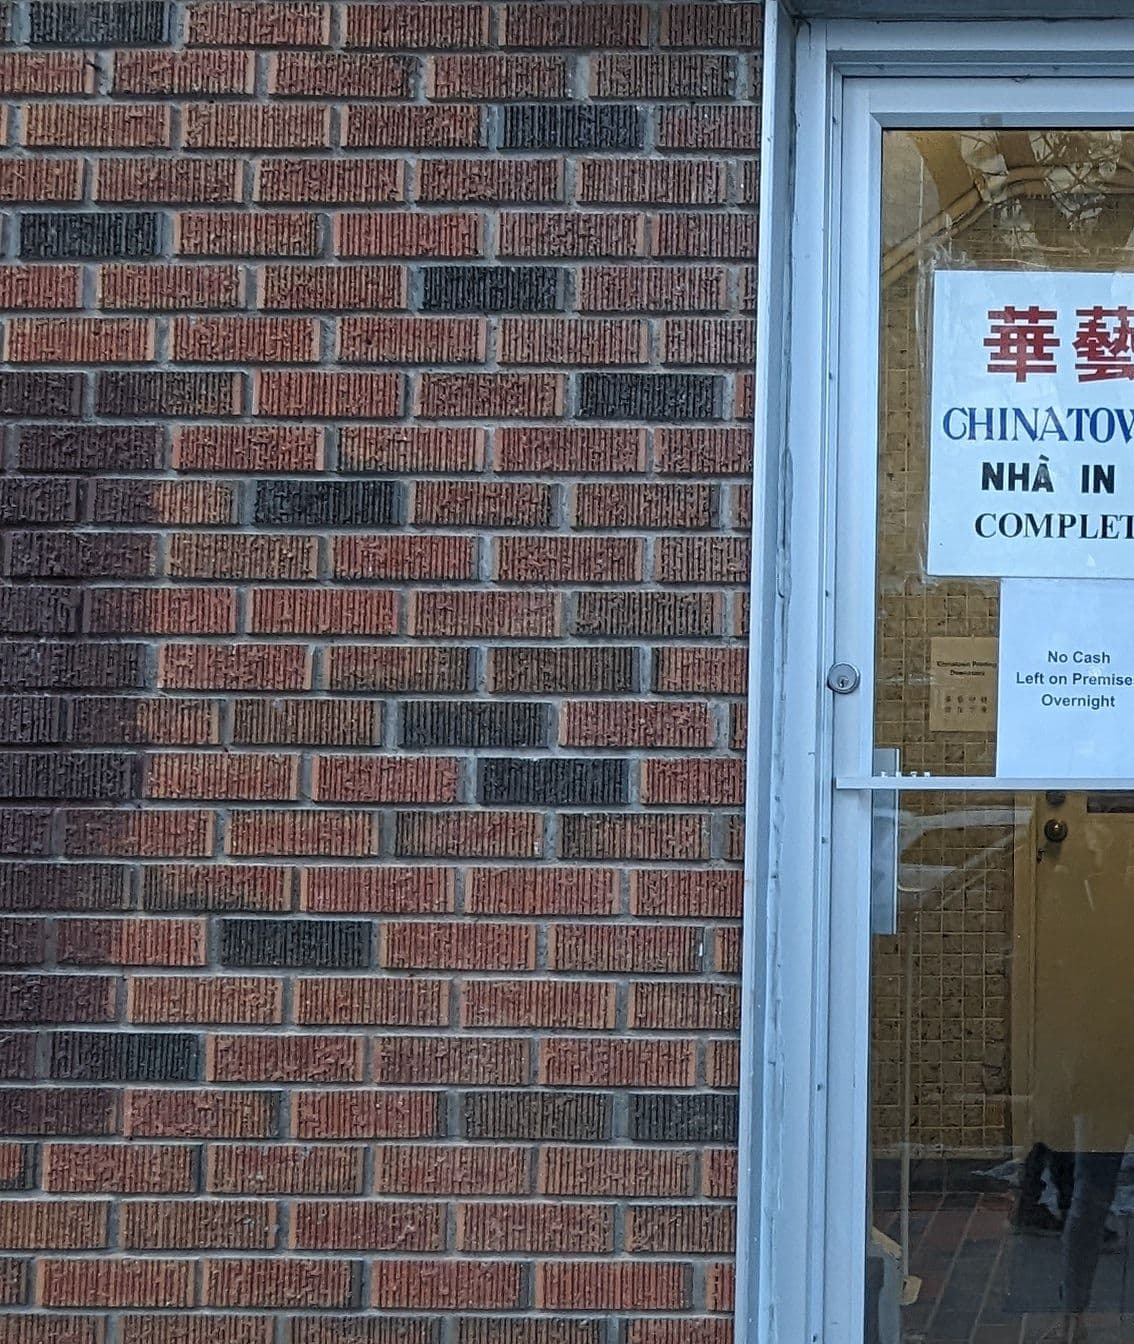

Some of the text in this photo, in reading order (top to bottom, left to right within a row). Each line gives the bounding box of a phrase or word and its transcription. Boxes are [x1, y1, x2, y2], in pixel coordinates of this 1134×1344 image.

[981, 454, 1054, 493] NHÀ
[1081, 464, 1115, 494] IN
[1047, 650, 1111, 664] No Cash
[1016, 671, 1044, 685] Left
[1048, 675, 1067, 685] on
[1041, 693, 1116, 710] Overnight
